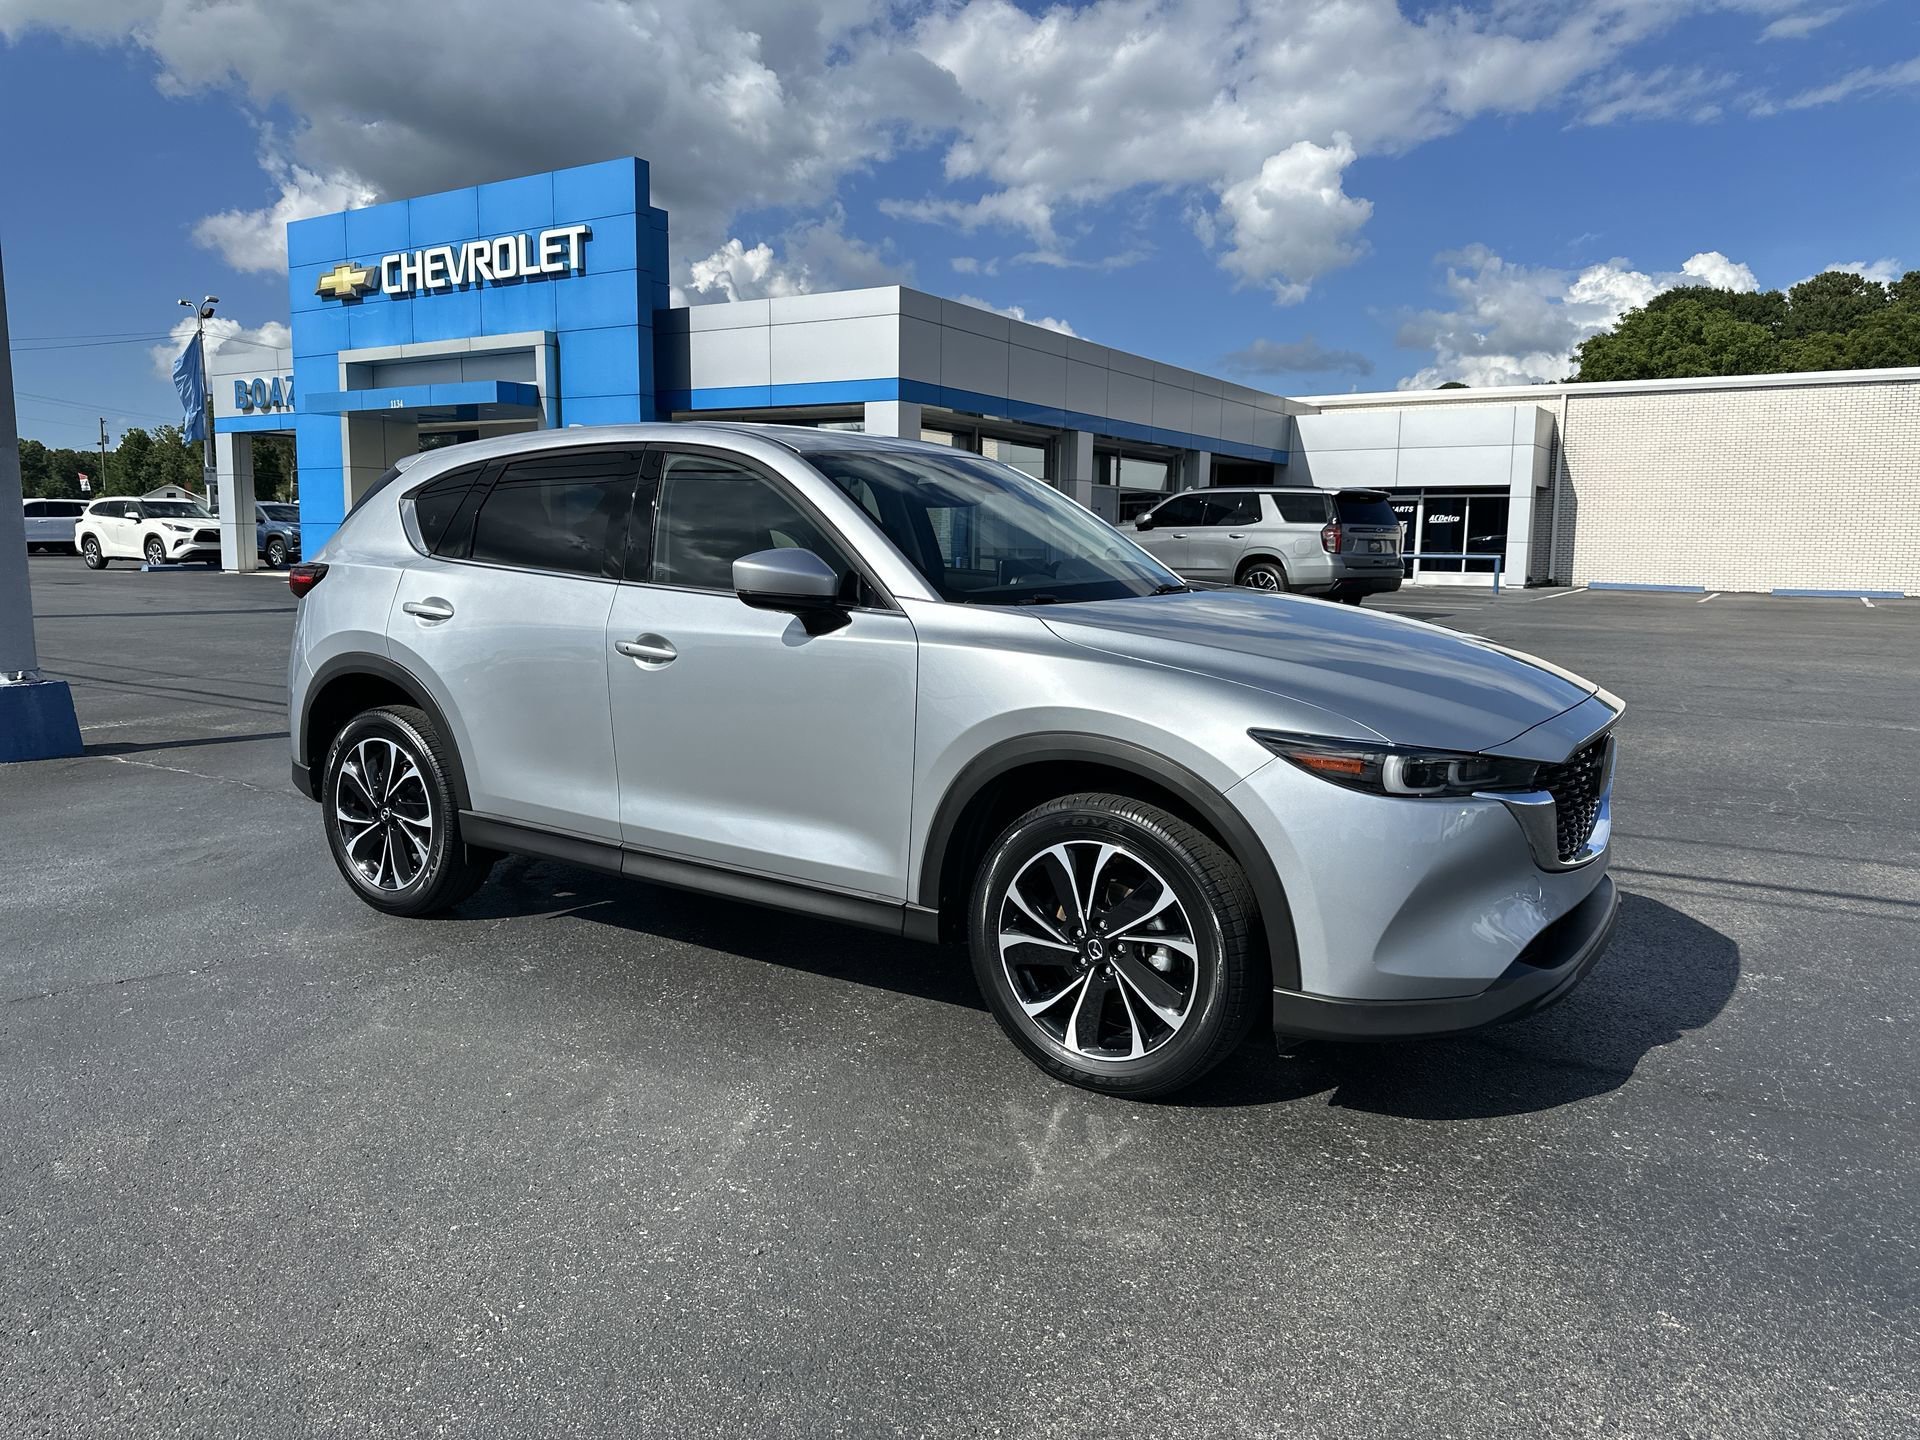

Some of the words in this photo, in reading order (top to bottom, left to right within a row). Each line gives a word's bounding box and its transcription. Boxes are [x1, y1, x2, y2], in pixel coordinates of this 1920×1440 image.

[381, 224, 589, 294] CHEVROLET
[390, 399, 403, 409] 1134
[1392, 505, 1414, 513] ARTS
[1429, 514, 1460, 524] ACDelco
